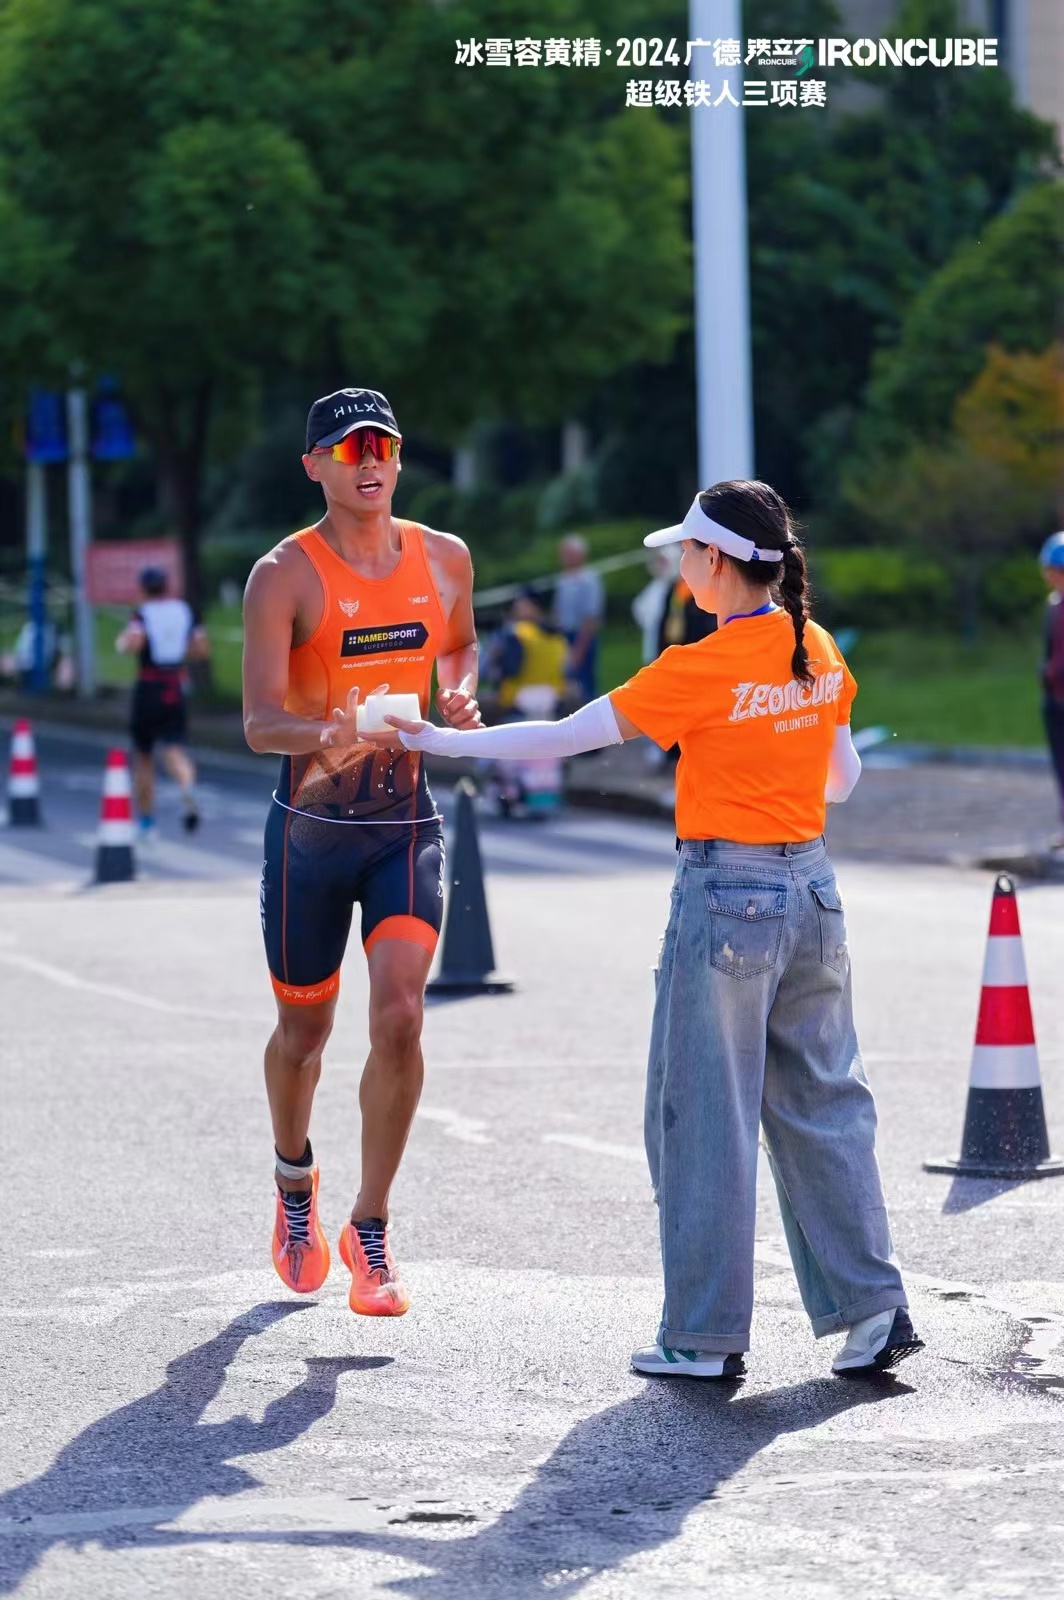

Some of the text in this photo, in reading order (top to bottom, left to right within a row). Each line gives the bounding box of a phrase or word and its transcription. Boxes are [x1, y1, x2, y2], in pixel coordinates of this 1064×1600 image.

[333, 403, 377, 418] HILX
[357, 629, 417, 644] NAMEDSPORT
[363, 641, 403, 651] SUPERFOOD
[774, 713, 819, 734] VOLUNTEER
